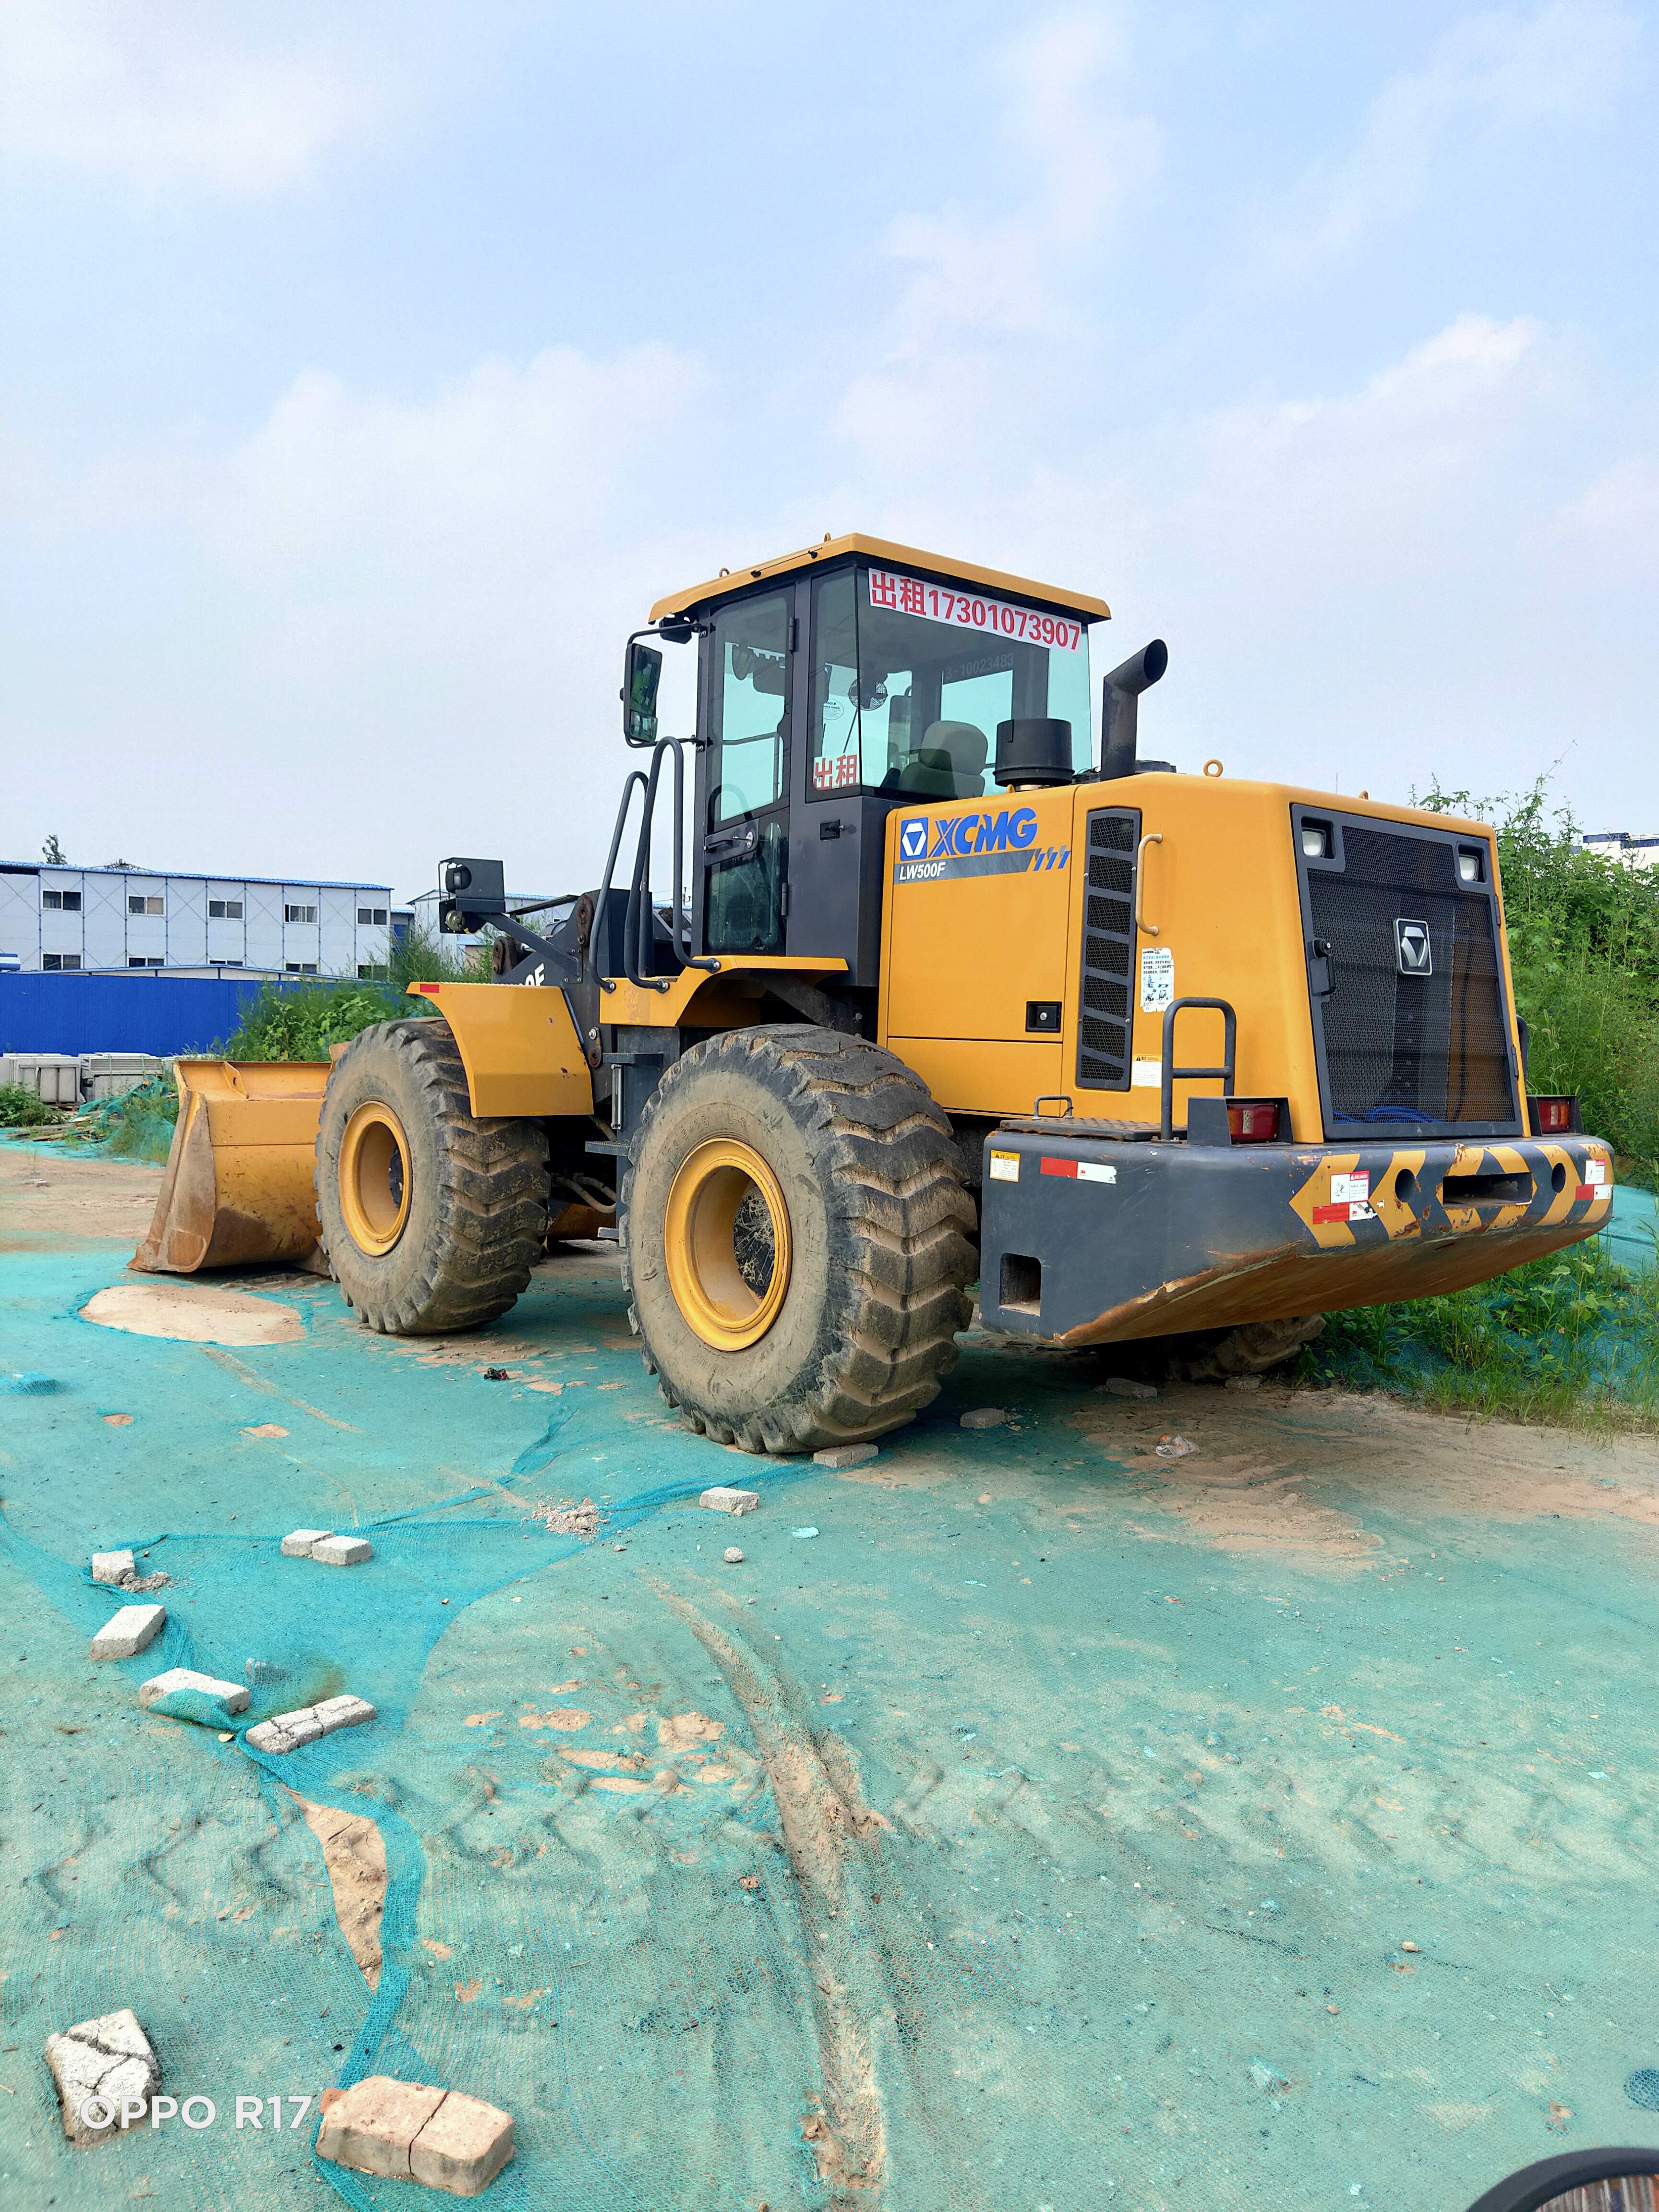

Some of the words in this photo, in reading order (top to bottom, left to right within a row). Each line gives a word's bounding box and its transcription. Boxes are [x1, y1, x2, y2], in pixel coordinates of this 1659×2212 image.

[871, 572, 1080, 650] 出租17301073907
[815, 754, 858, 790] 出租
[928, 807, 1037, 858] XCMG
[899, 862, 946, 881] LW500F
